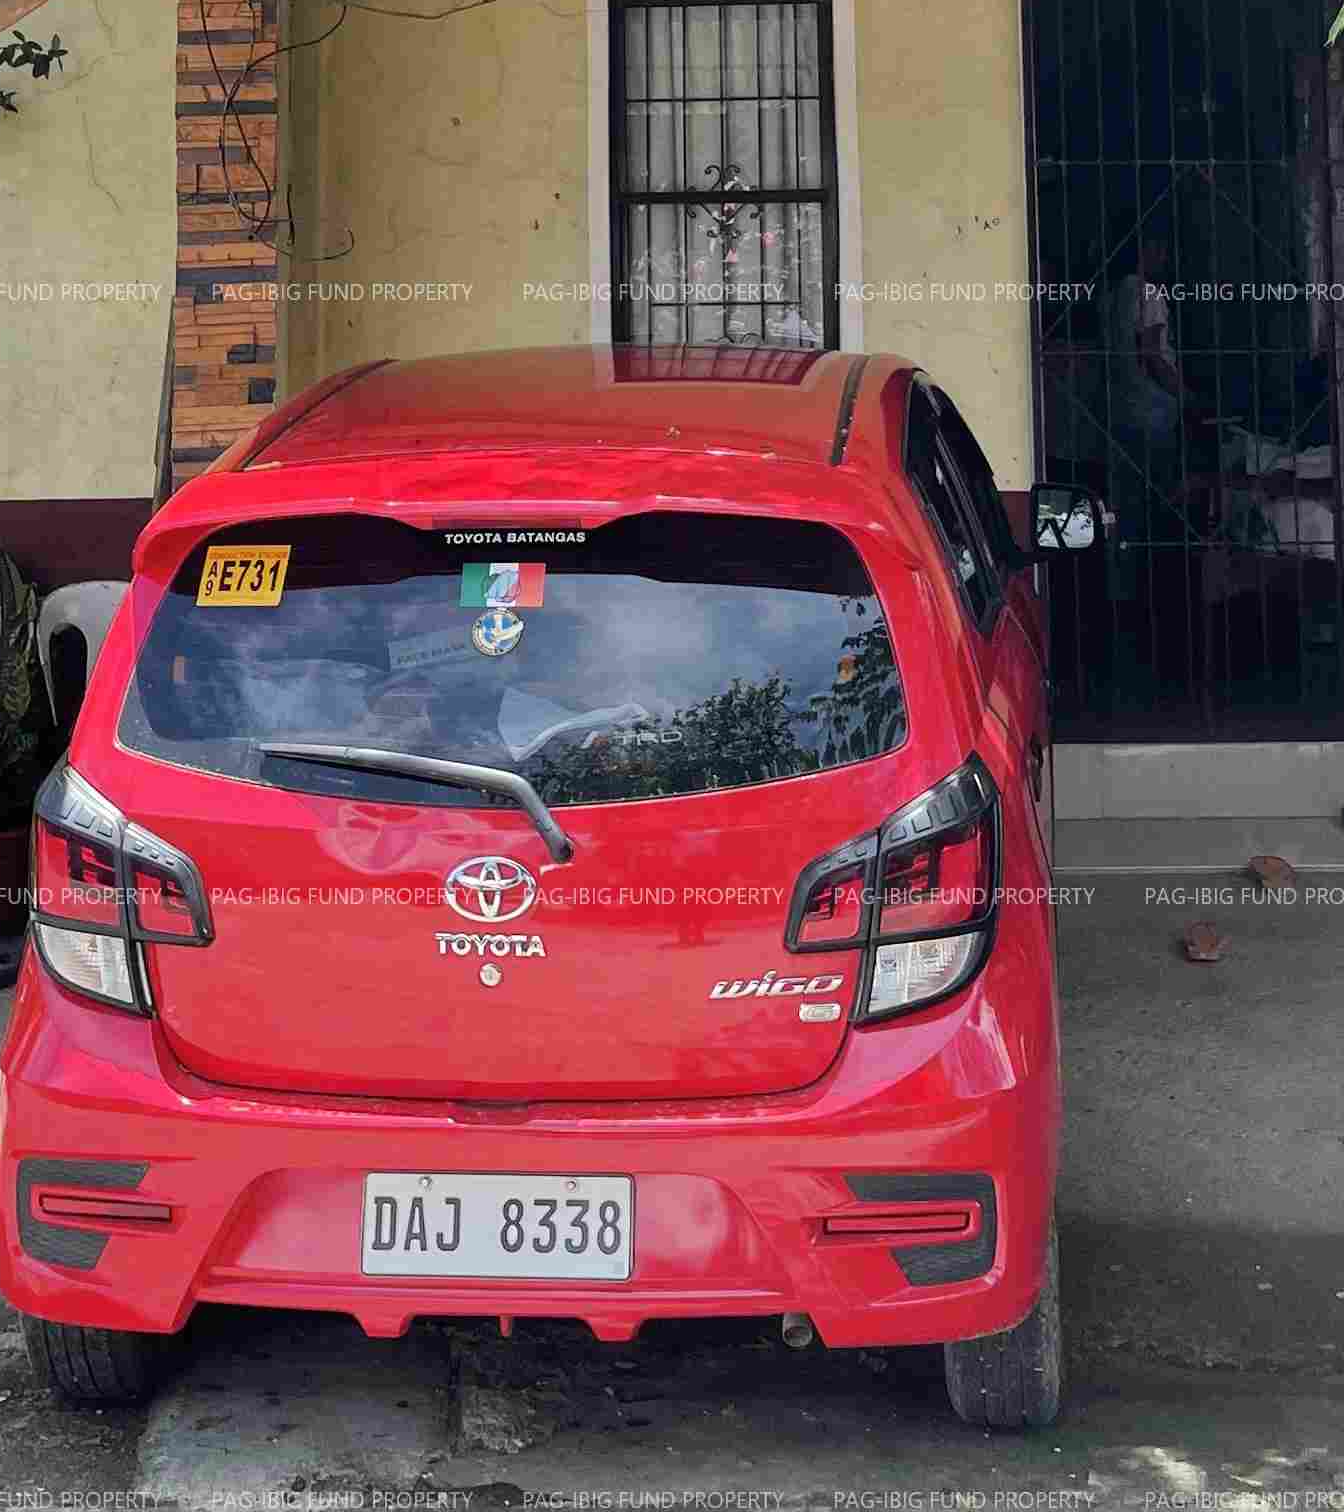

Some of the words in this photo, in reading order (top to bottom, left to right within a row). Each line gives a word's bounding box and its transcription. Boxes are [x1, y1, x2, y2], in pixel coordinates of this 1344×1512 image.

[445, 532, 502, 545] TOYOTA
[507, 531, 586, 543] BATANGAS
[218, 560, 281, 592] E731
[434, 931, 546, 957] TOYOTA
[371, 1196, 462, 1252] DAJ
[499, 1197, 622, 1255] 8338
